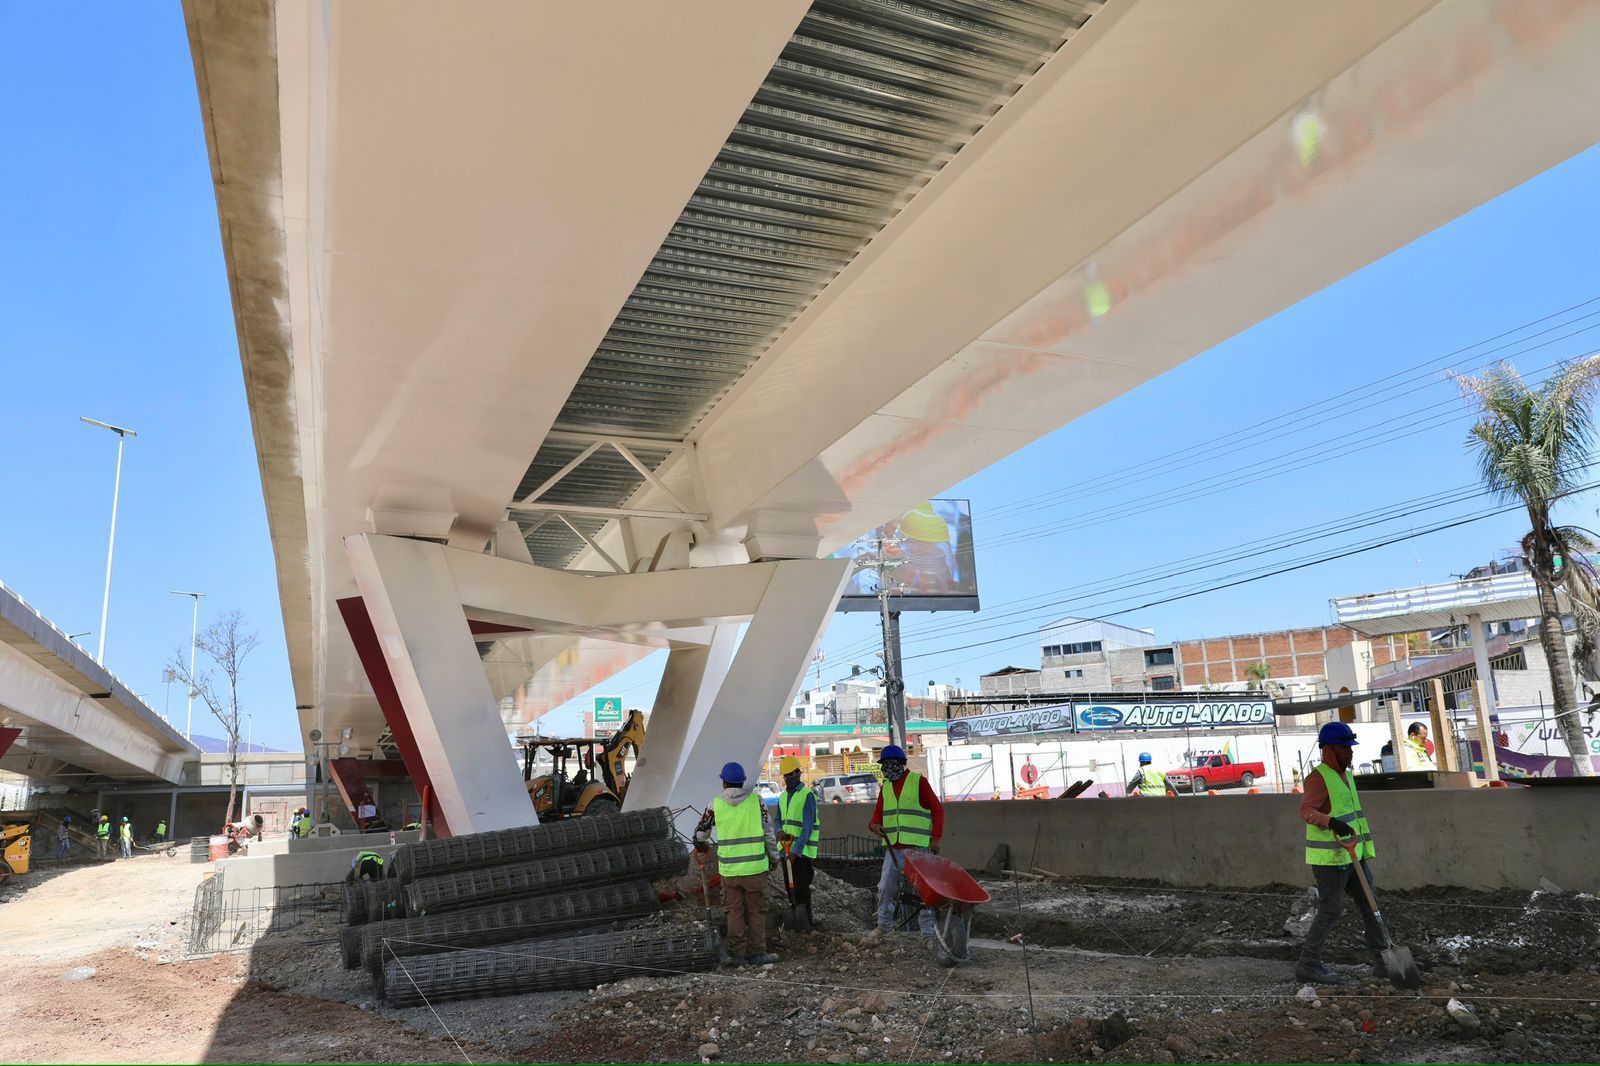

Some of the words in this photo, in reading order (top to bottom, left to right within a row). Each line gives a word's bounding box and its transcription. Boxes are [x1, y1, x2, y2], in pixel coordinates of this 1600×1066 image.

[973, 710, 1061, 732] AUTOLAVADO
[1124, 704, 1266, 726] AUTOLAVADO
[1538, 726, 1600, 741] ULR
